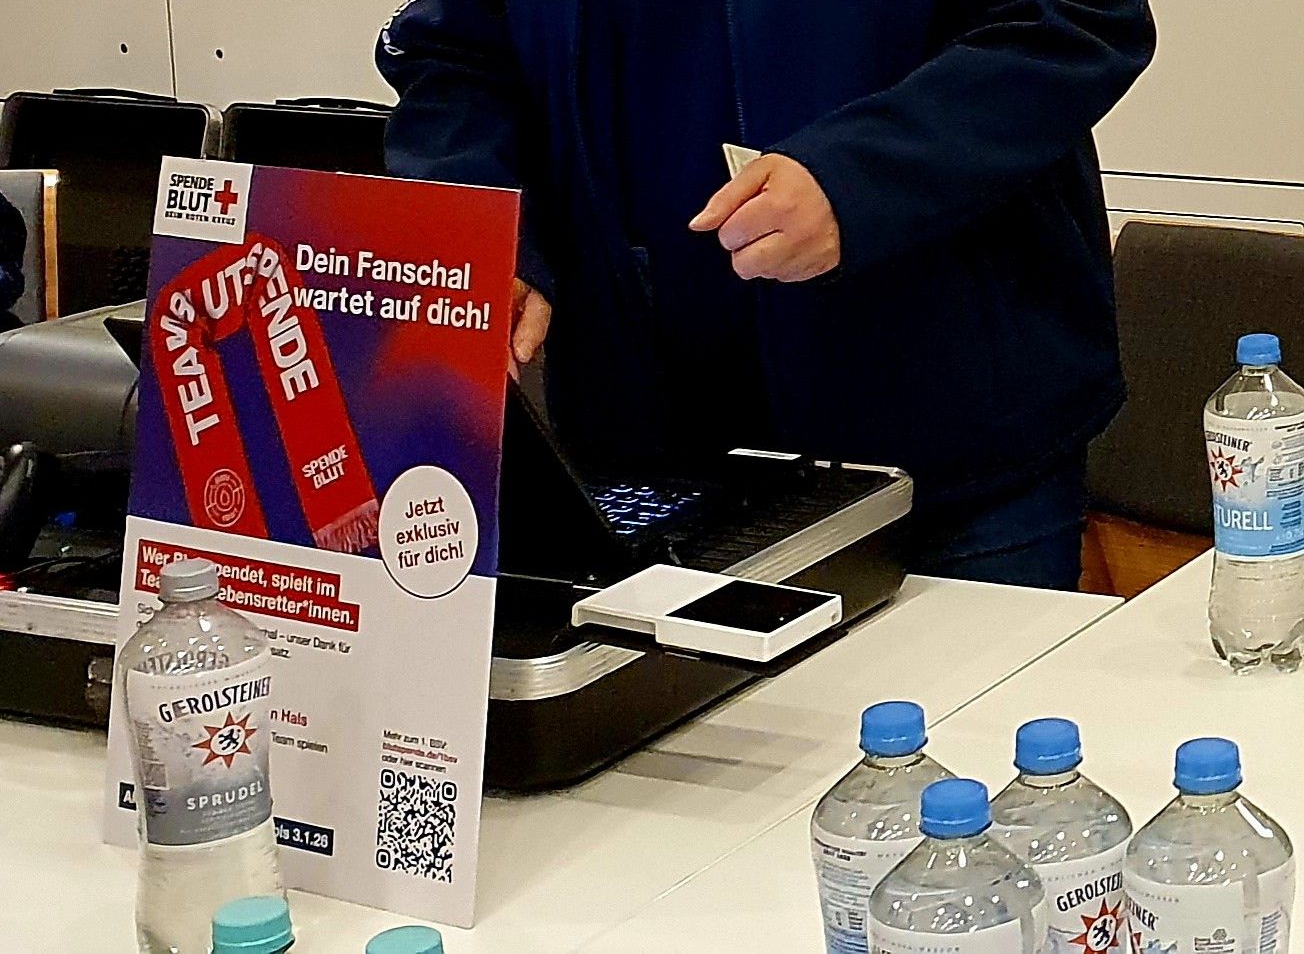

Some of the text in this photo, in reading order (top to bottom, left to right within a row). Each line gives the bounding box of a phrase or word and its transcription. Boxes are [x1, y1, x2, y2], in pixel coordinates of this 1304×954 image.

[169, 173, 215, 191] SPENDE
[166, 189, 212, 213] BLUT
[296, 243, 472, 291] Dein Fanschal
[293, 286, 491, 331] wartet auf dich!
[301, 444, 349, 478] SPENDE
[312, 461, 346, 490] BLUT
[405, 496, 445, 519] Jetzt
[1215, 504, 1274, 531] TURELL
[396, 518, 460, 545] exklusiv
[398, 540, 464, 569] für dich!
[142, 545, 170, 567] Wer
[214, 564, 268, 588] pendet,
[271, 572, 314, 593] spielt
[315, 578, 336, 598] im
[214, 584, 355, 626] ebensretterinnen.
[281, 709, 308, 727] Hals
[186, 780, 264, 811] SPRUDEL
